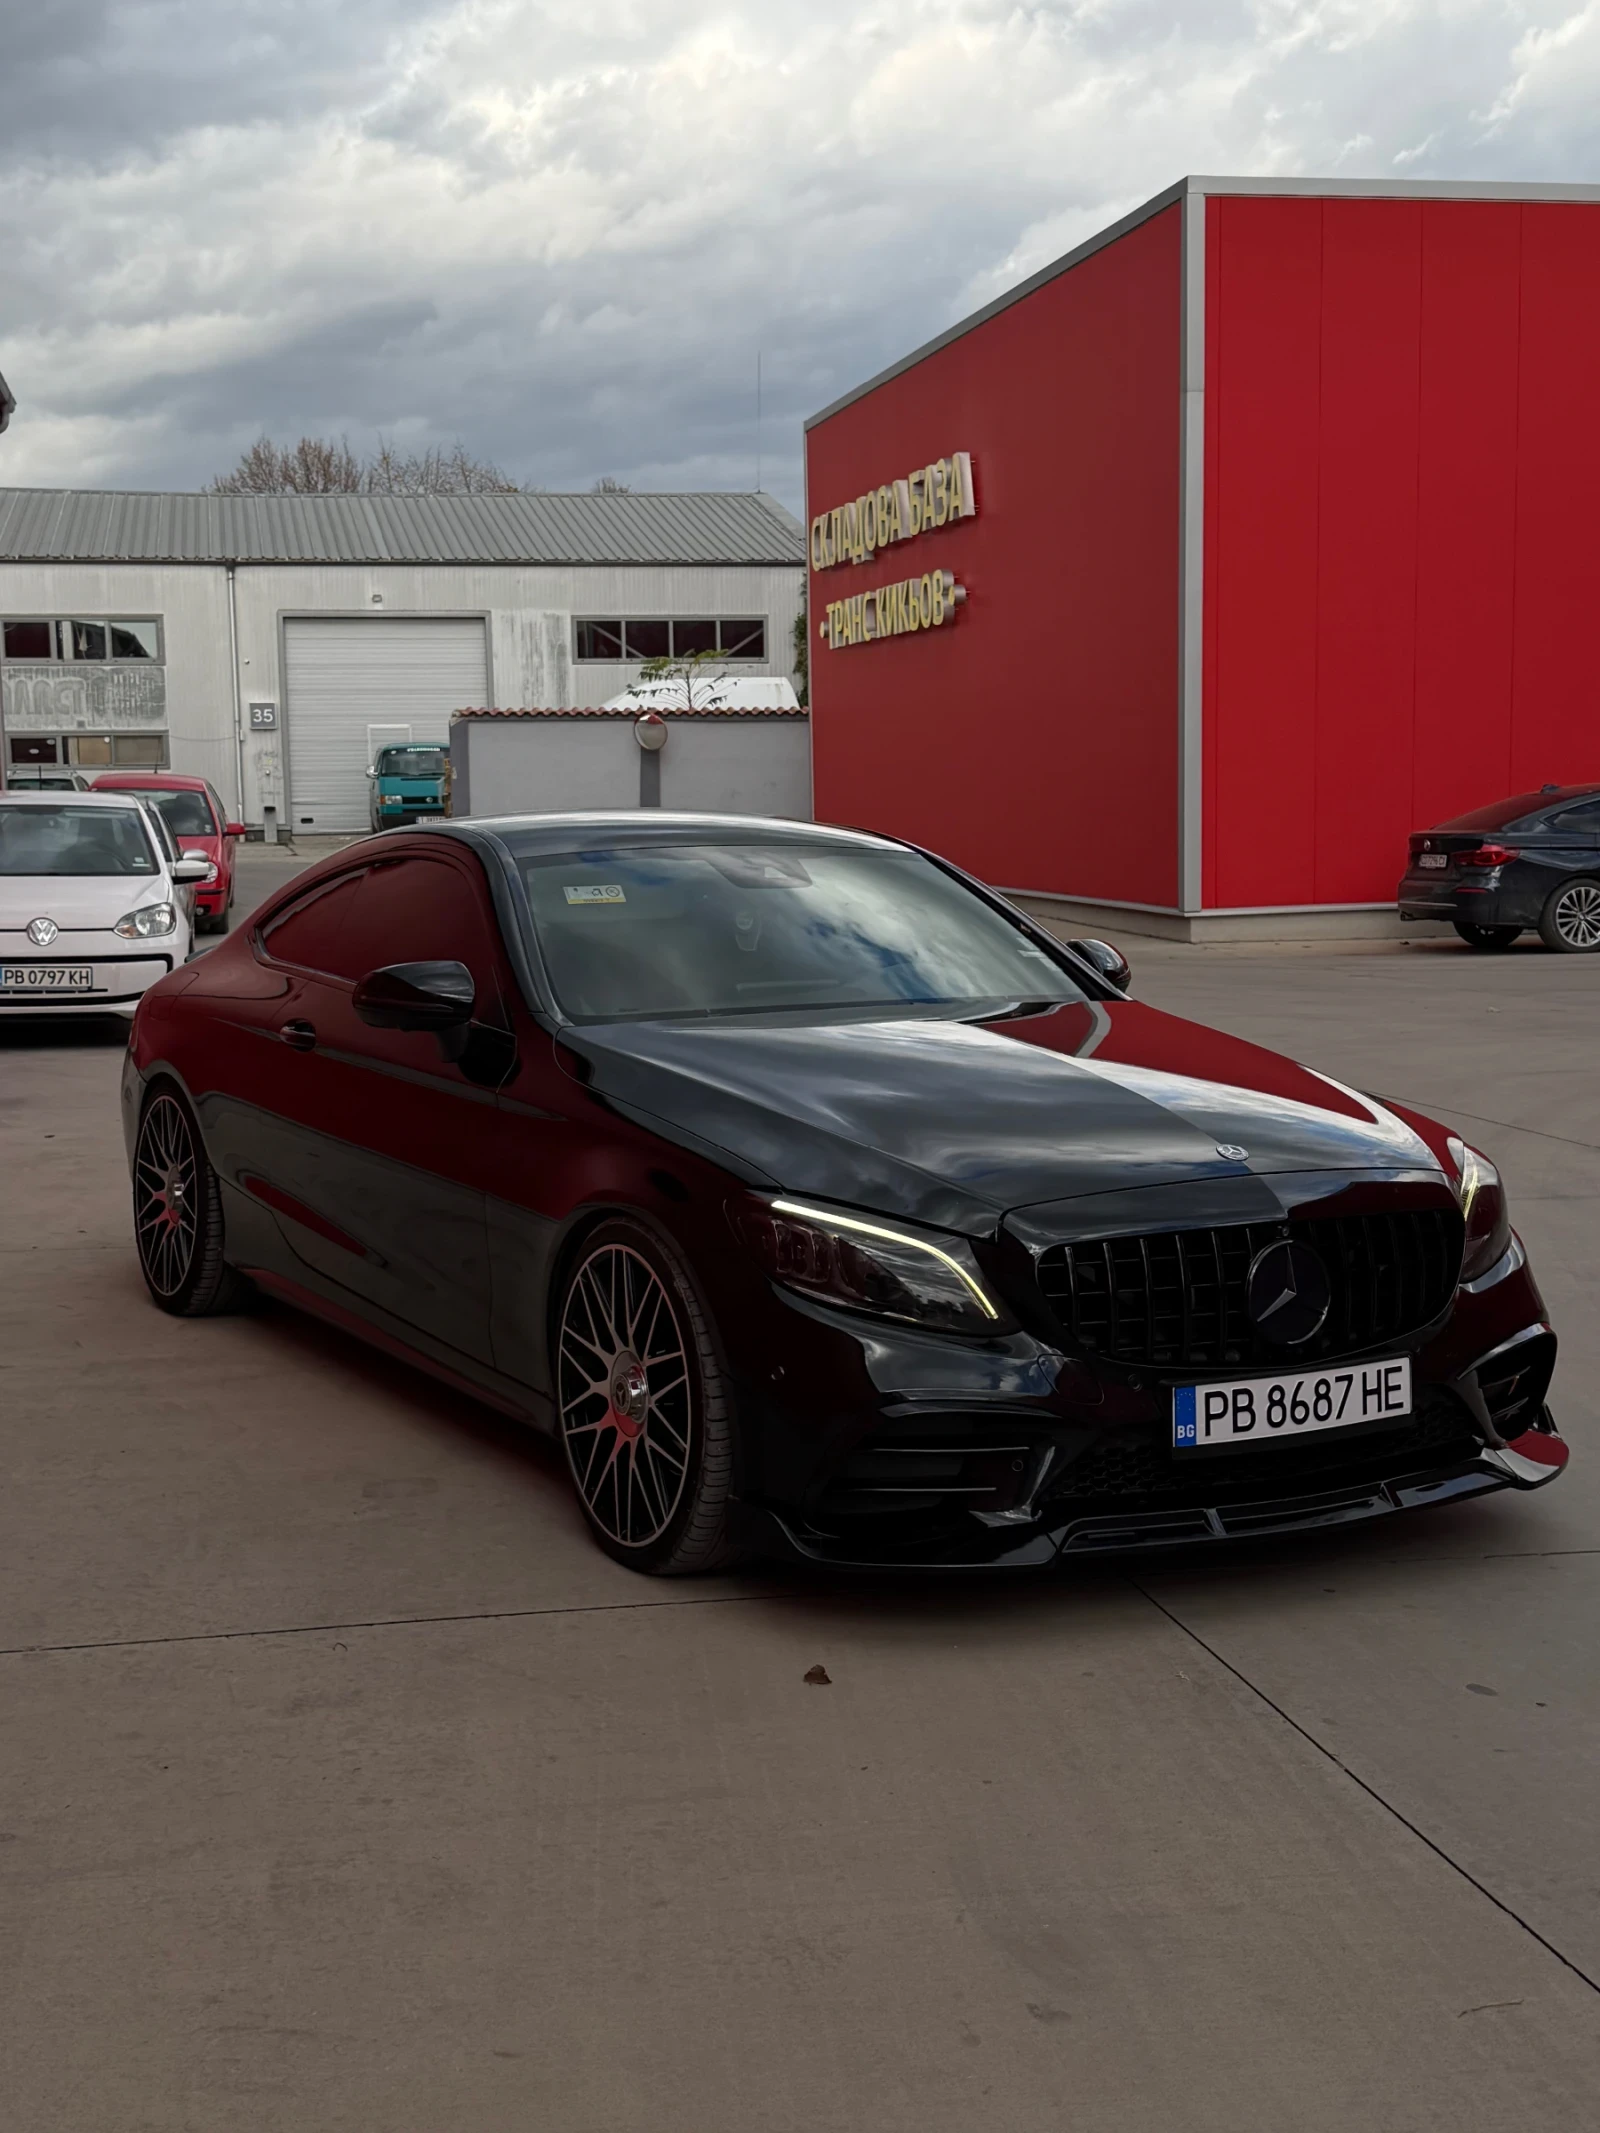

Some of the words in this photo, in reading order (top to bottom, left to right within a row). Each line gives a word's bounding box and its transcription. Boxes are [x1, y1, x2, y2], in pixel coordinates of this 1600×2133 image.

[811, 480, 913, 571] СКЛАДОВА
[908, 452, 975, 535] БАЗА
[826, 591, 876, 649] ТРАНС
[876, 569, 952, 637] КИКЬОВ
[253, 709, 273, 722] 35
[4, 970, 25, 984] PB
[28, 970, 66, 984] 0797
[69, 970, 90, 984] KH
[1204, 1387, 1256, 1437] PB
[1266, 1373, 1354, 1429] 8687
[1361, 1365, 1404, 1416] HE
[1177, 1425, 1195, 1439] BG
